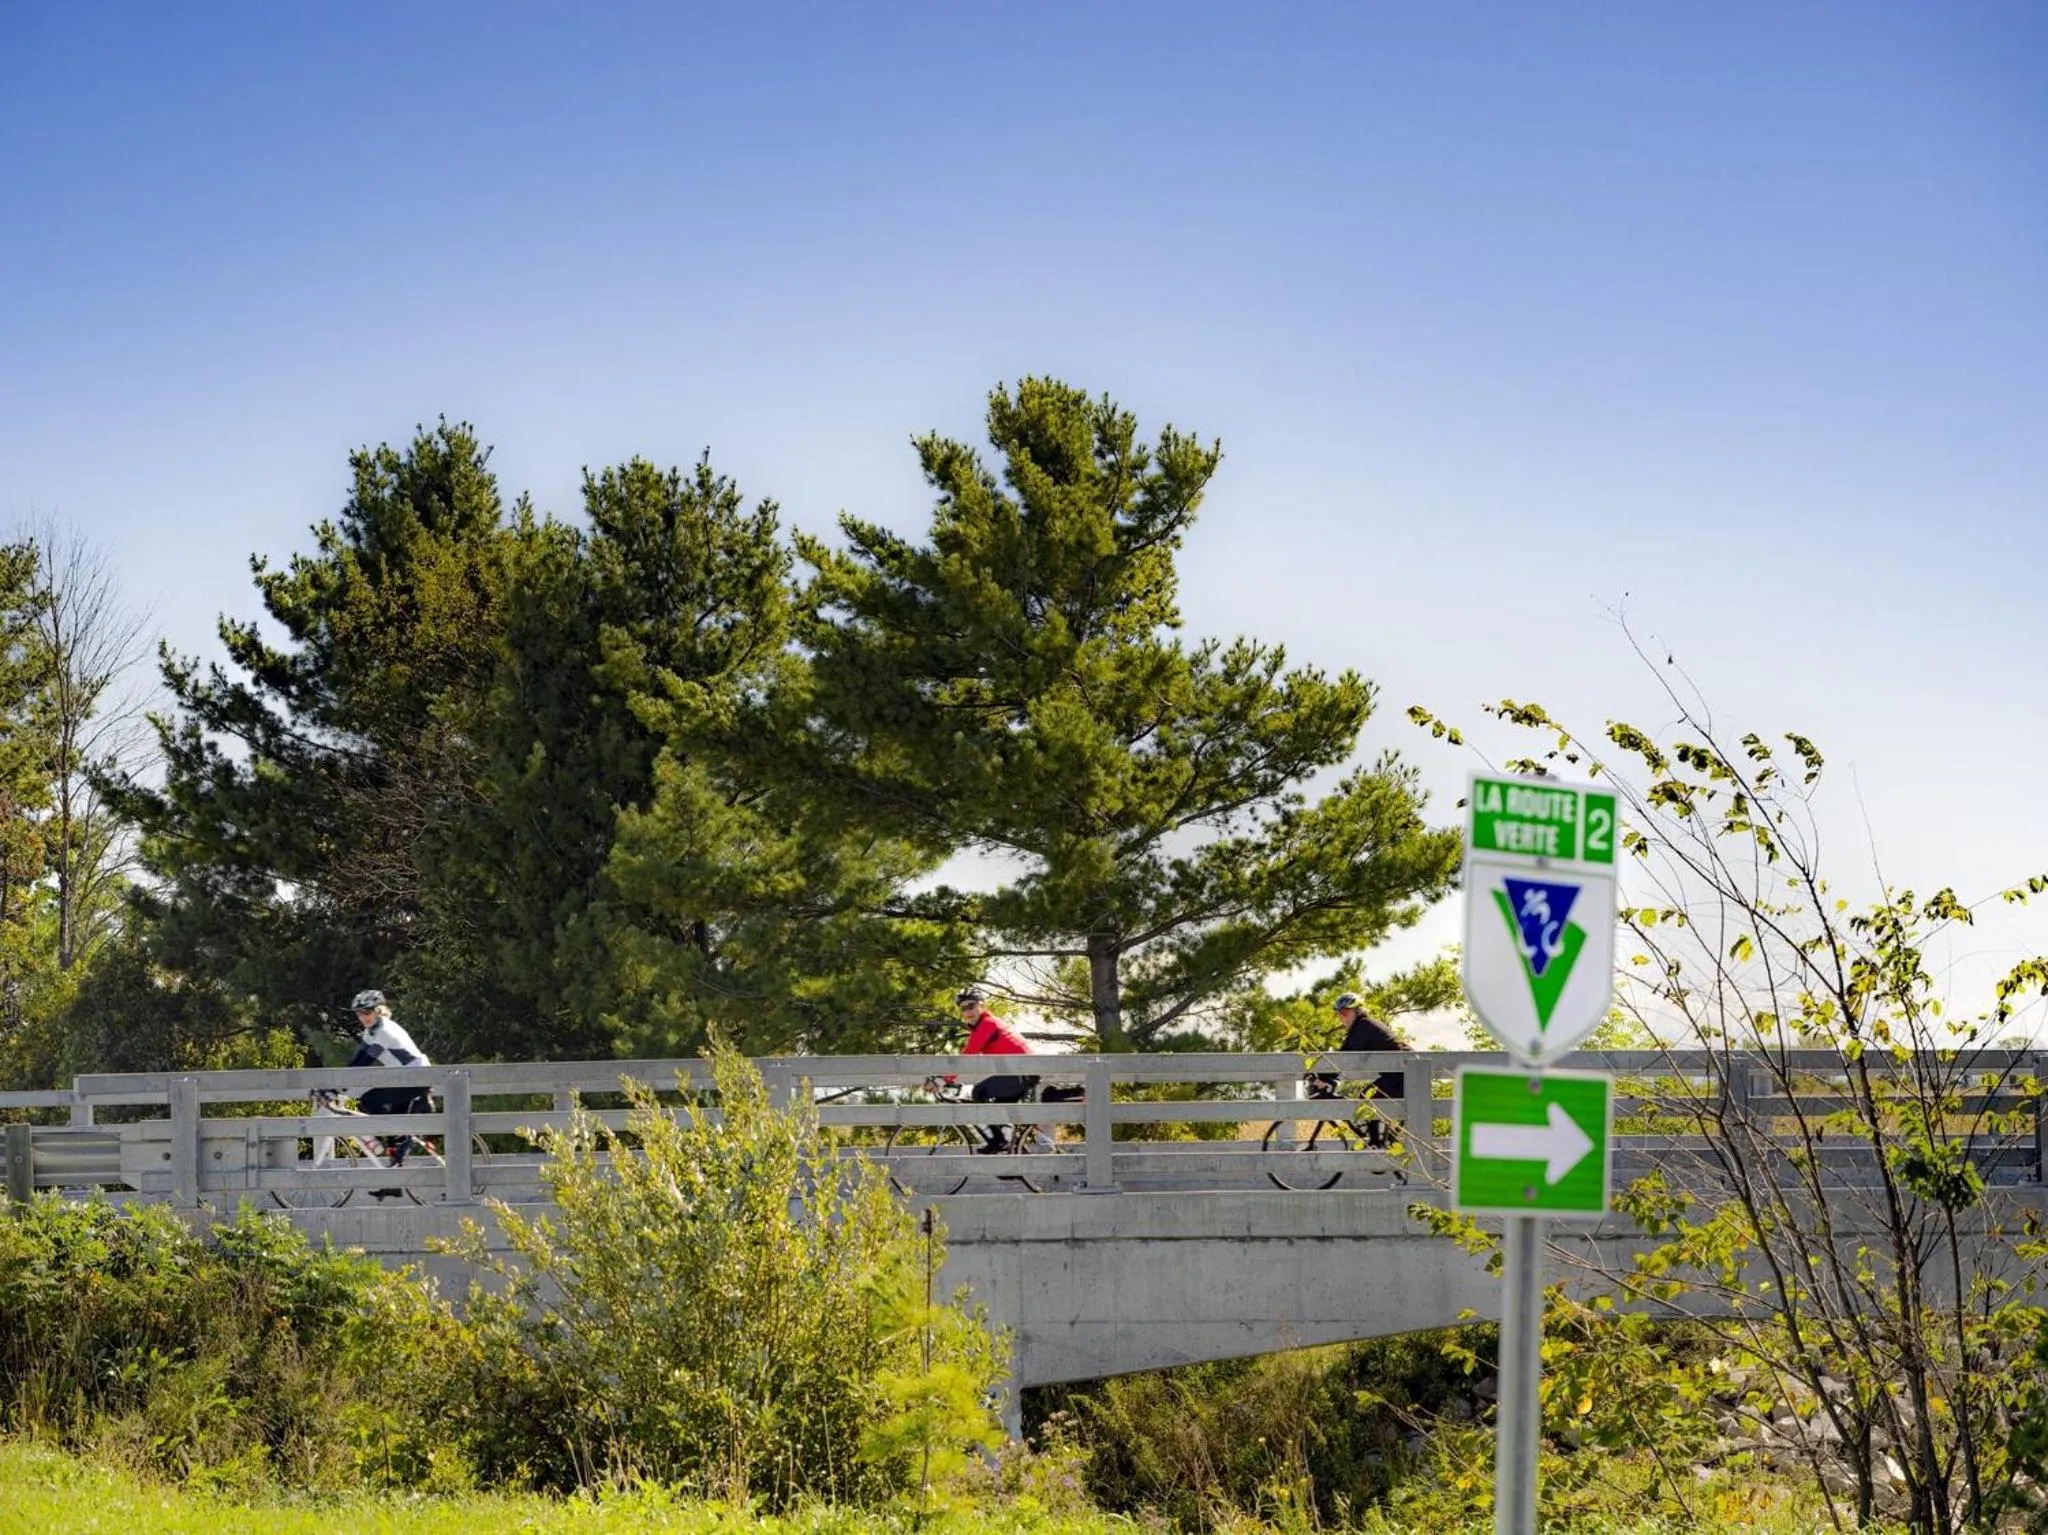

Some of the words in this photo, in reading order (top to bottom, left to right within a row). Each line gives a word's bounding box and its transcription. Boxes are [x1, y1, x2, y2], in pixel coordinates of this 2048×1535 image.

[1475, 784, 1503, 813] LA
[1506, 786, 1575, 823] ROUTE
[1493, 820, 1560, 855] VERTE
[1587, 808, 1611, 850] 2
